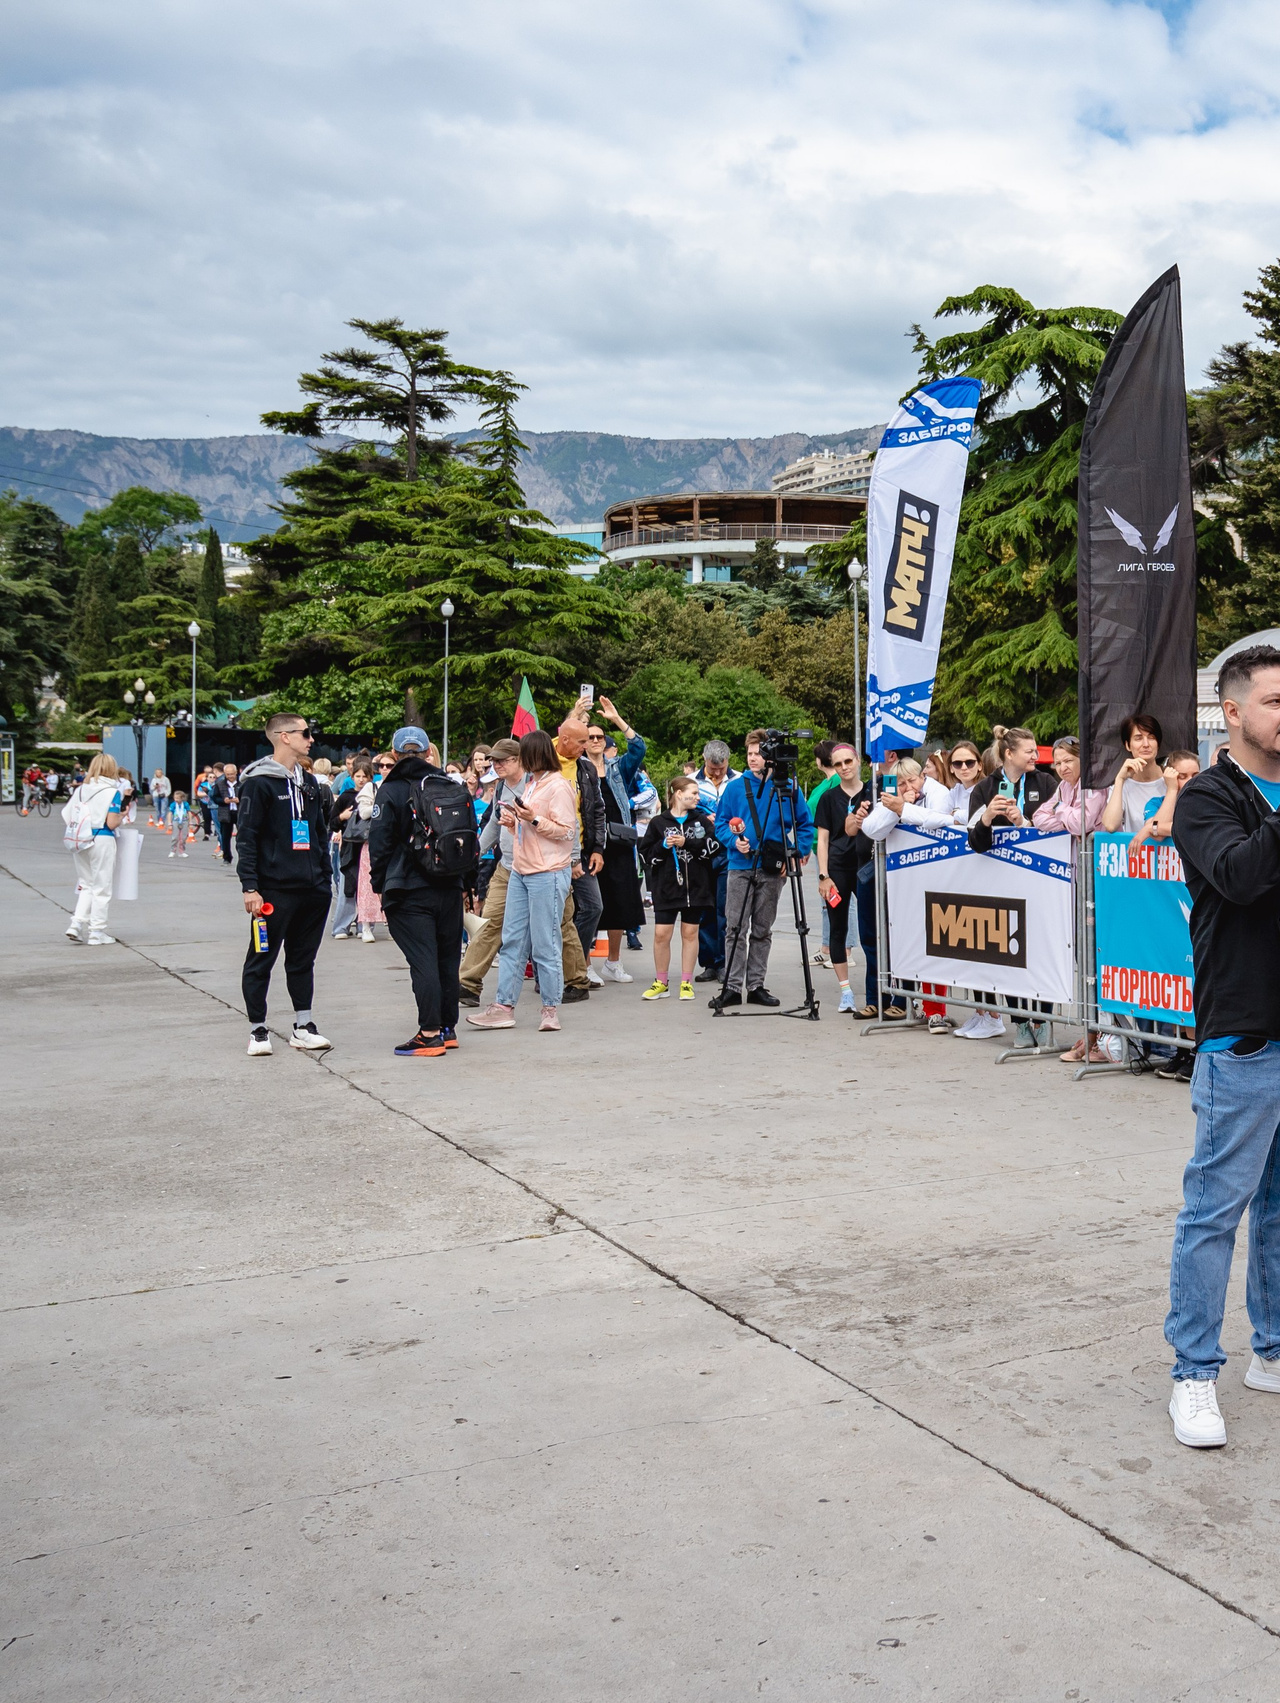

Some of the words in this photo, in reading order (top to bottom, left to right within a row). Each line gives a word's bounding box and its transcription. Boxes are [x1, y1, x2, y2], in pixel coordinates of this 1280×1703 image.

[898, 421, 972, 444] ЗАБЕГ.РФ
[886, 502, 931, 630] МАТЧ!
[1117, 563, 1145, 572] ЛИГА
[1147, 562, 1176, 572] ГЕРОЕВ
[899, 845, 949, 866] ЗАБЕГ.РФ
[931, 902, 1020, 955] МАТЧ!
[1101, 964, 1193, 1013] #ГОРДОСТЬ
